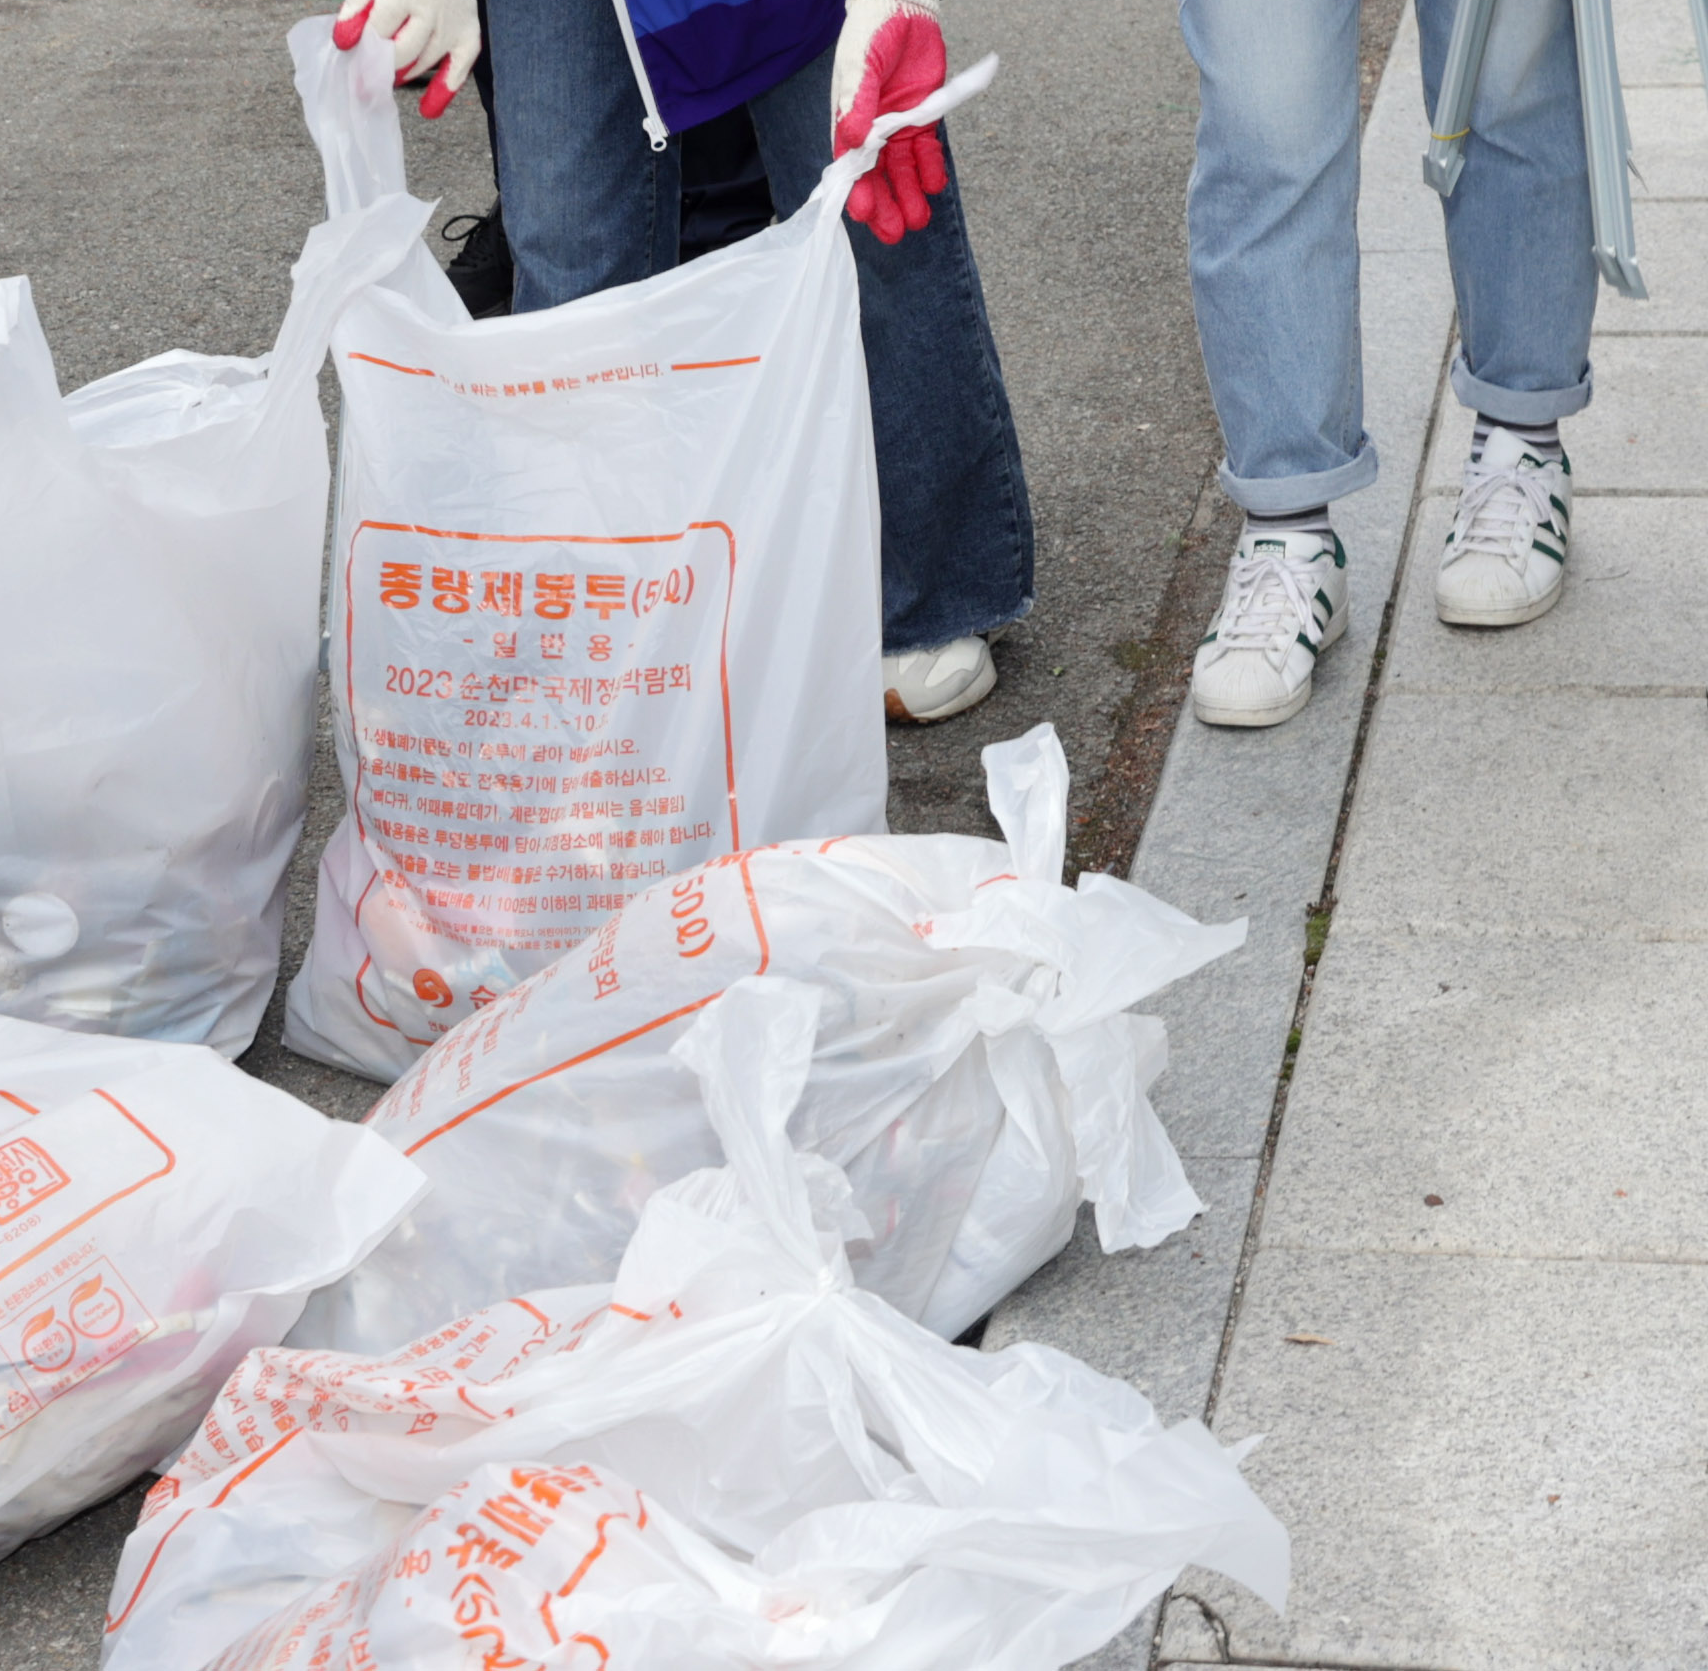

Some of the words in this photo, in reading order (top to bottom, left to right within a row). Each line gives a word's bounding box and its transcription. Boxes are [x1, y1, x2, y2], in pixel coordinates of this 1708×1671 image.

[470, 382, 499, 397] 위는
[502, 379, 546, 397] 봉투를
[586, 362, 665, 385] 부분입니다.
[458, 741, 474, 759] 이
[669, 821, 716, 845] 합니다.
[432, 859, 461, 879] 또는
[545, 861, 605, 885] 수거하지
[609, 859, 671, 882] 않습니다.
[478, 894, 492, 911] 시
[541, 893, 584, 913] 이하의
